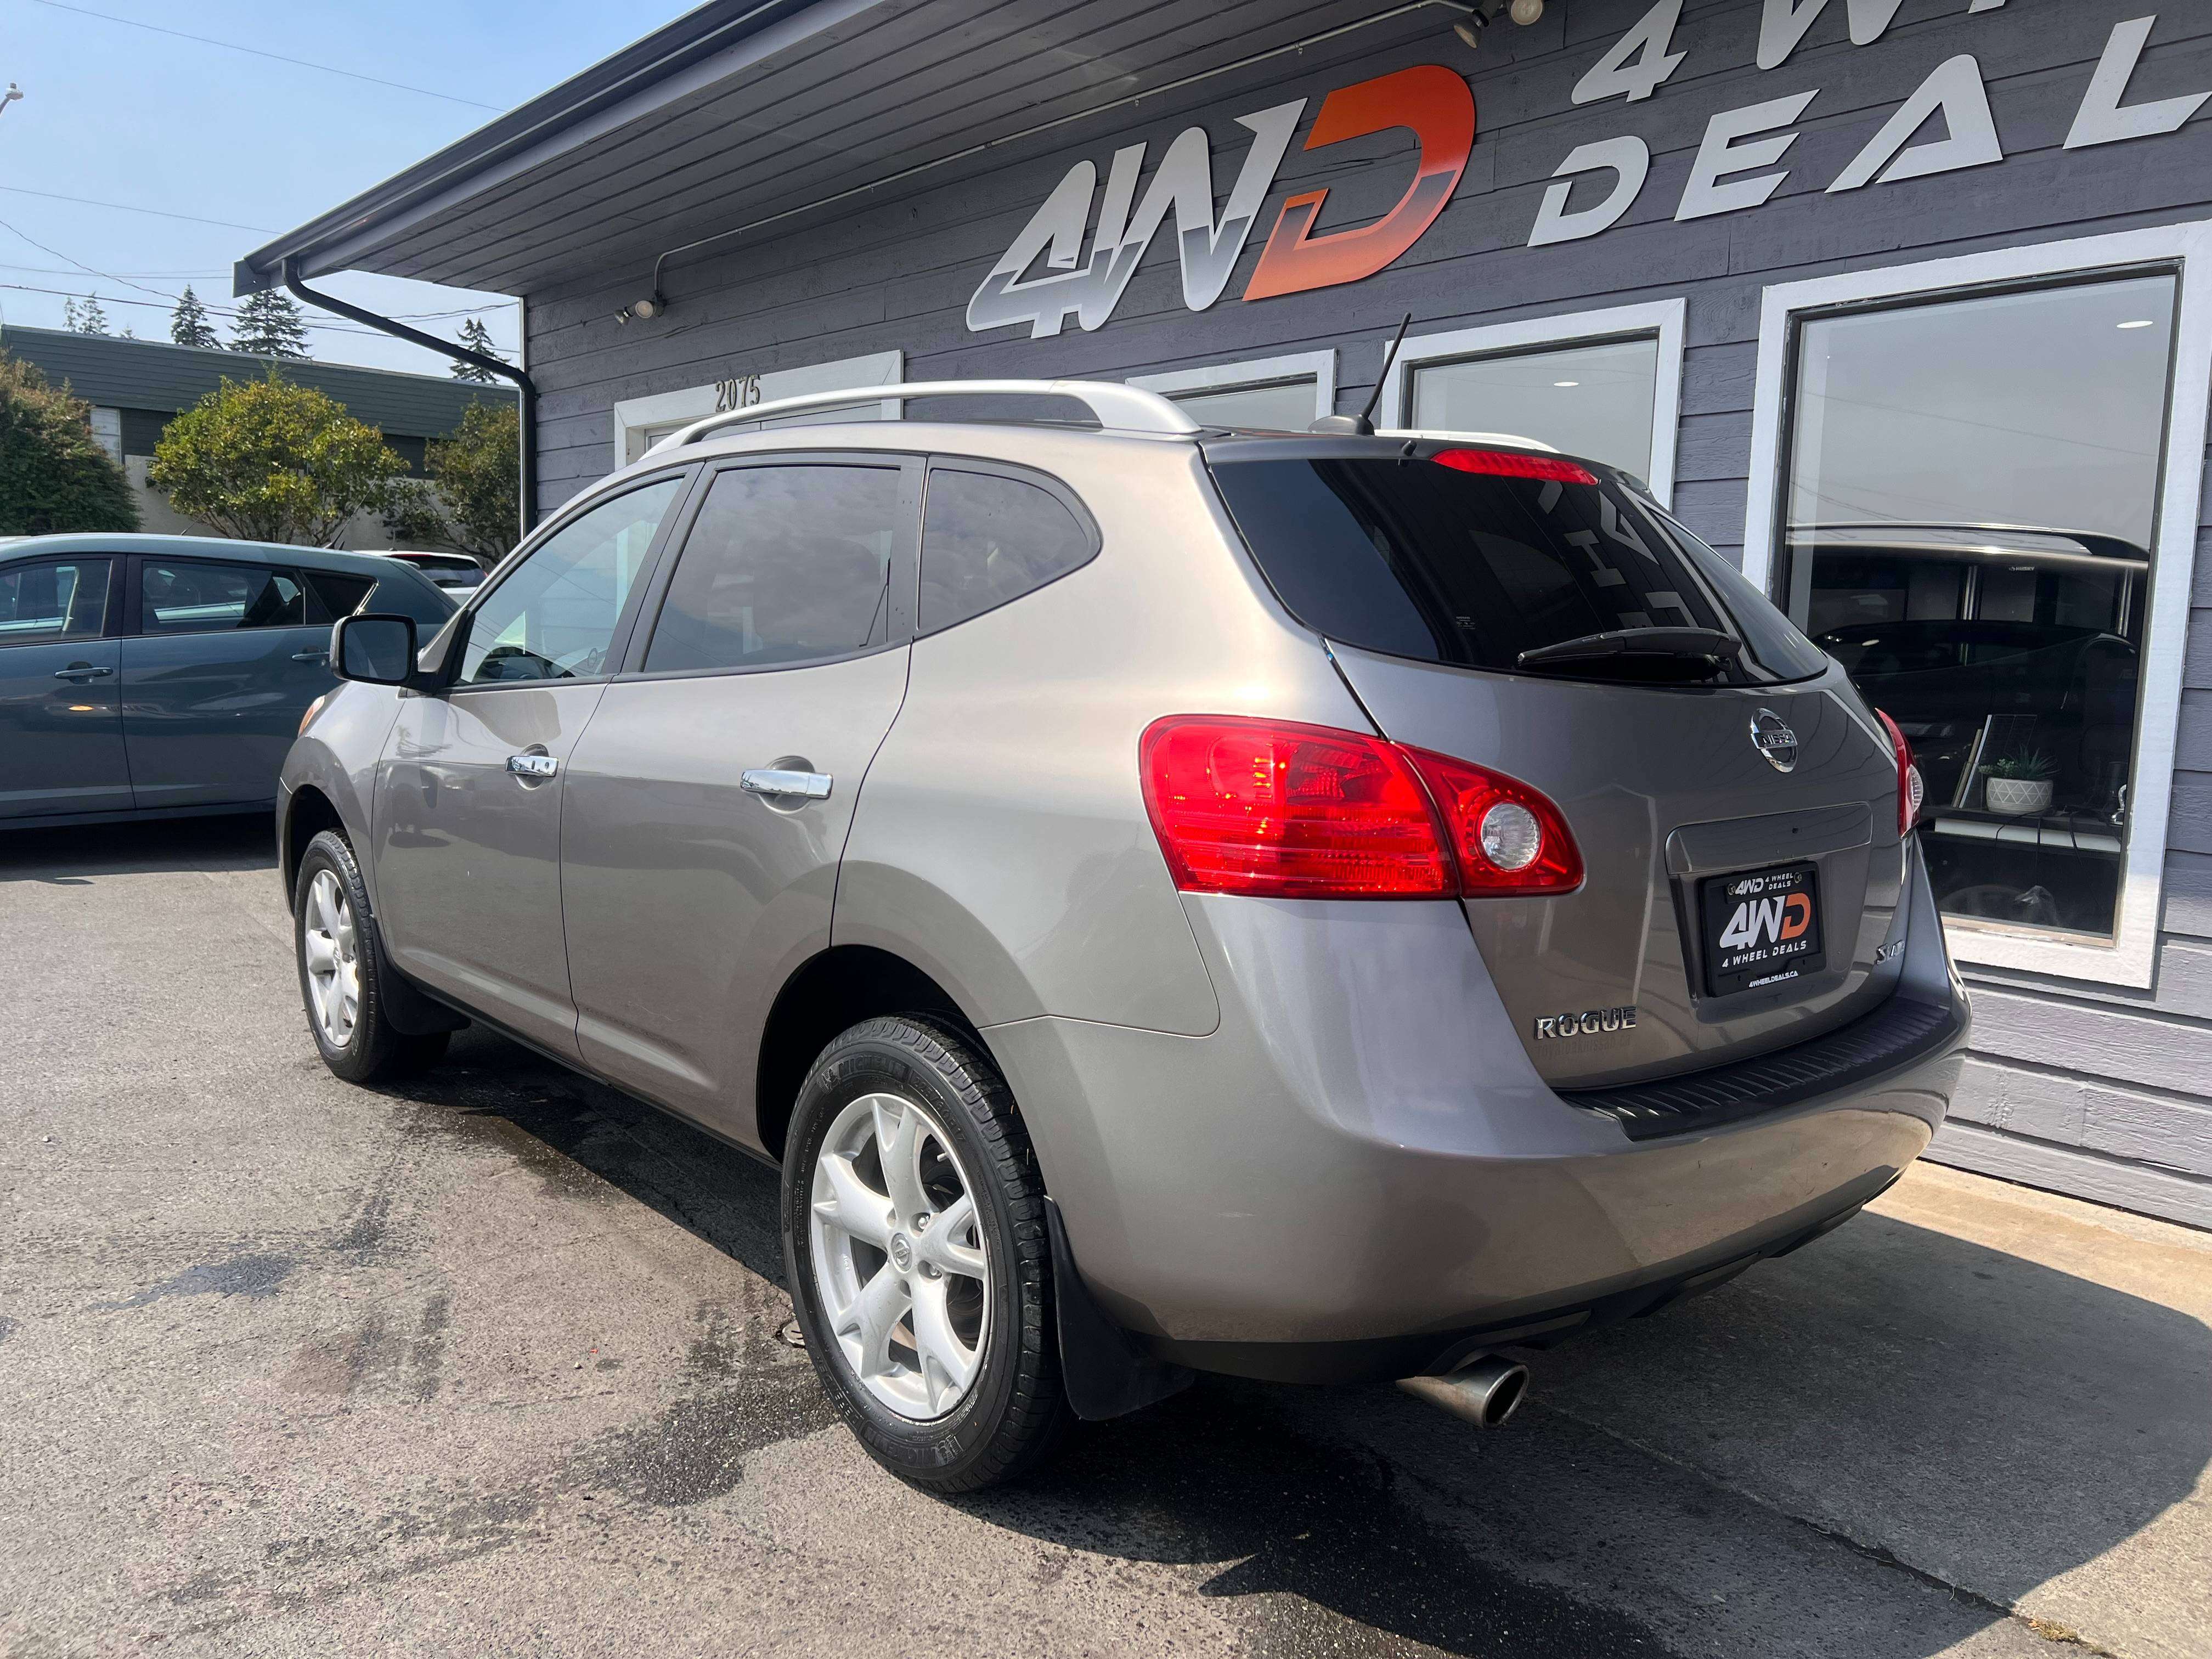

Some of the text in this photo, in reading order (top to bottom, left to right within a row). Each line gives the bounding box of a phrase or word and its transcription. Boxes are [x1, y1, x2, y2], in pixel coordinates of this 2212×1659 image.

[1527, 14, 2212, 247] DEAL
[966, 64, 1476, 339] 4WD
[715, 374, 760, 413] 2075
[1735, 878, 1764, 895] 4WD
[1769, 881, 1791, 890] DEALS
[1771, 873, 1793, 882] WHEEL
[1719, 893, 1811, 950] 4WD
[1722, 939, 1807, 968] 4 WHEEL DEALS
[1748, 970, 1799, 988] 4WHEELDEALS.CA
[1534, 1006, 1637, 1040] ROGUE
